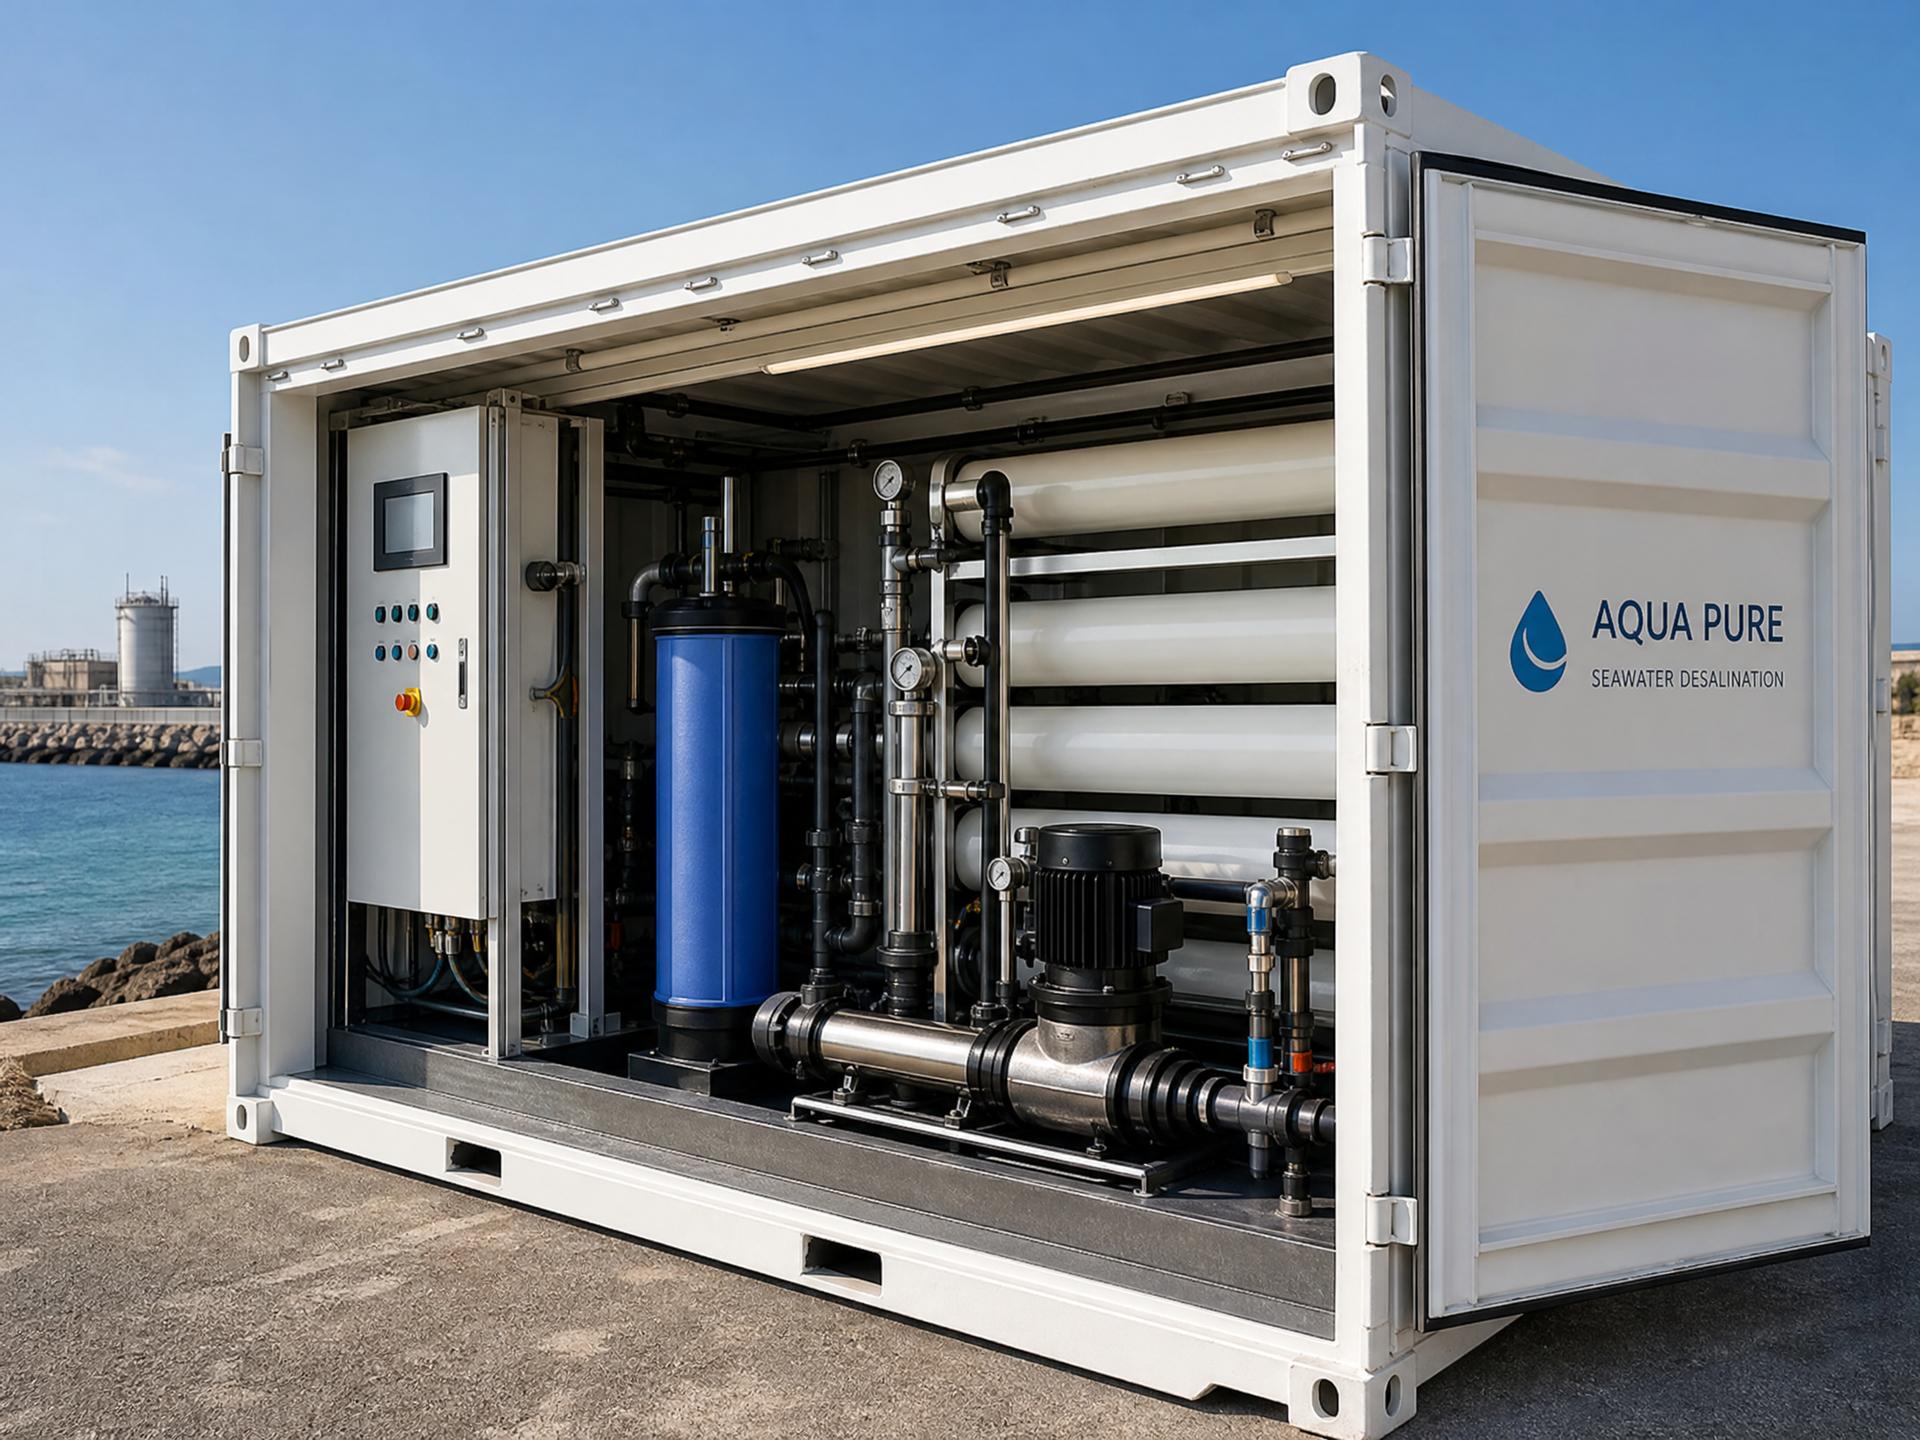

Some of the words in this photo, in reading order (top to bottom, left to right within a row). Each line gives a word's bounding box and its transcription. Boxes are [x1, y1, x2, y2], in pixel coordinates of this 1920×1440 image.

[1592, 600, 1693, 645] AQUA
[1704, 603, 1783, 642] PURE
[1591, 668, 1674, 687] SEAWATER
[1680, 670, 1784, 688] DESALINATION
